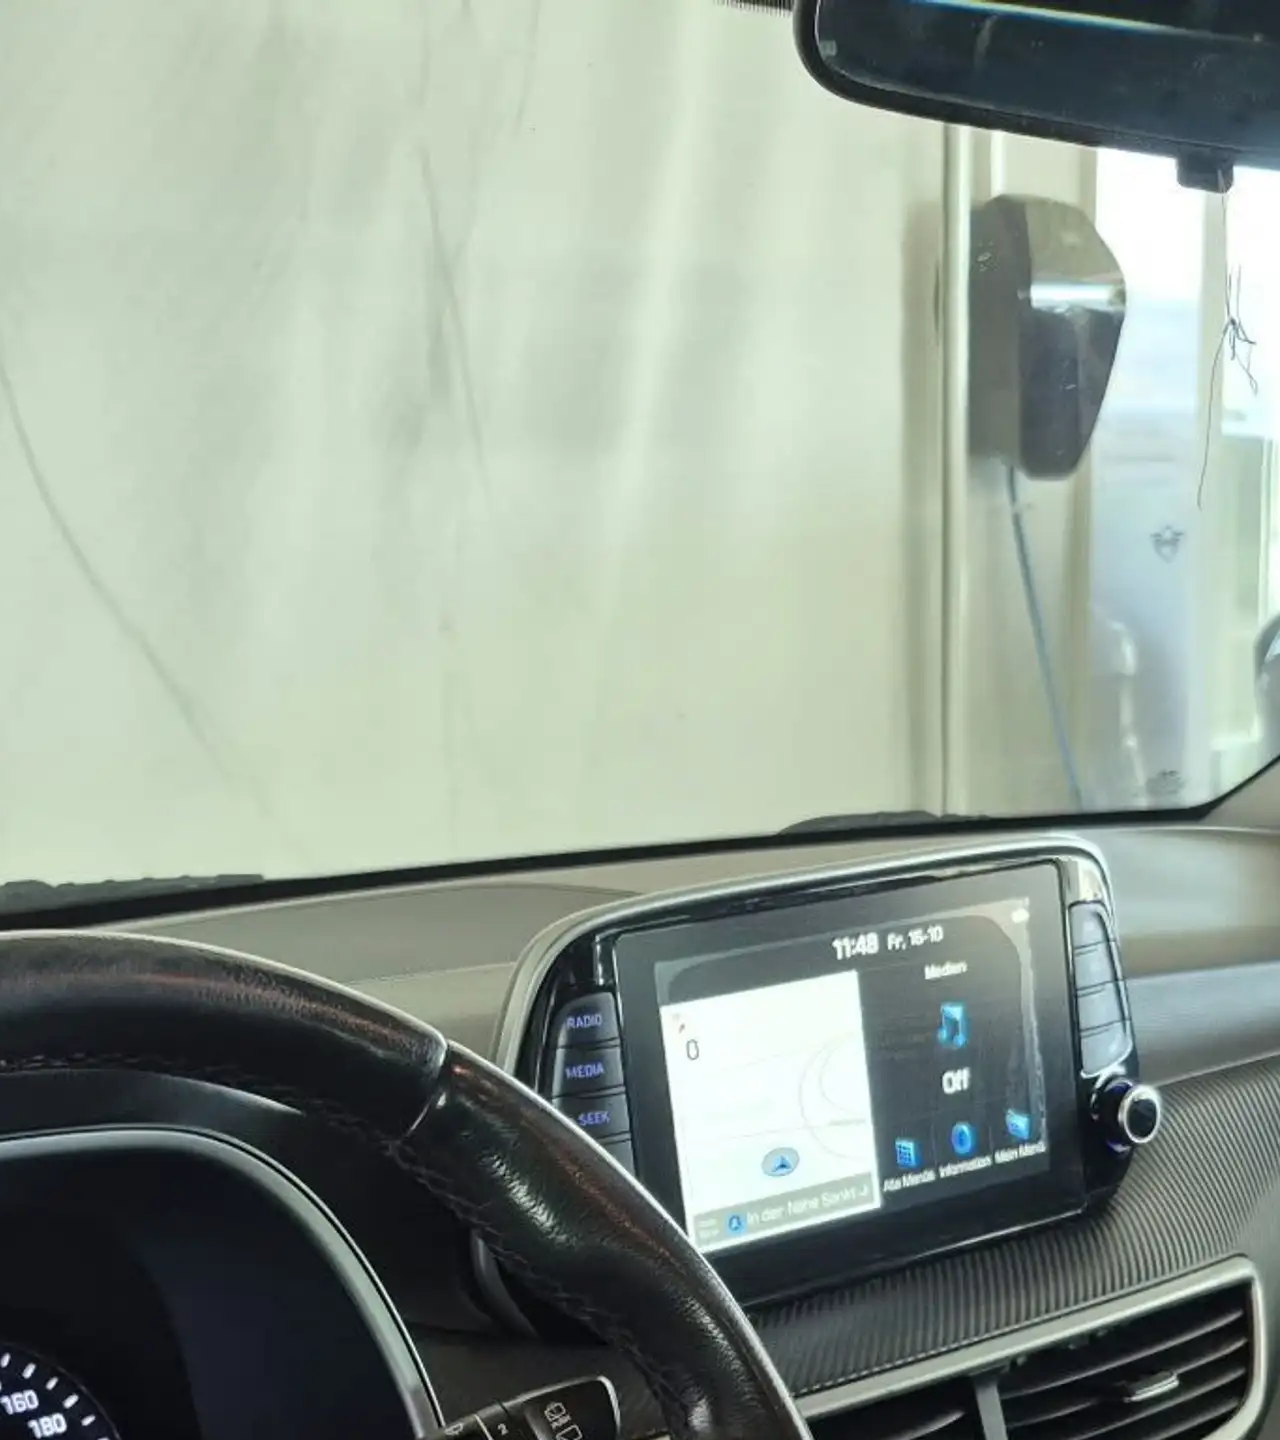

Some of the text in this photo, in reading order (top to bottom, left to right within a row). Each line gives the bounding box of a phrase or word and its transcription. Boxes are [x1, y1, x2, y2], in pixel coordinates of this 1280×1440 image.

[832, 931, 879, 960] 11:48
[567, 1013, 603, 1029] RADIO
[565, 1062, 604, 1079] MEDIA
[942, 1067, 970, 1094] Off
[578, 1111, 610, 1126] SEEK
[0, 1390, 39, 1415] 160
[27, 1413, 67, 1439] 180
